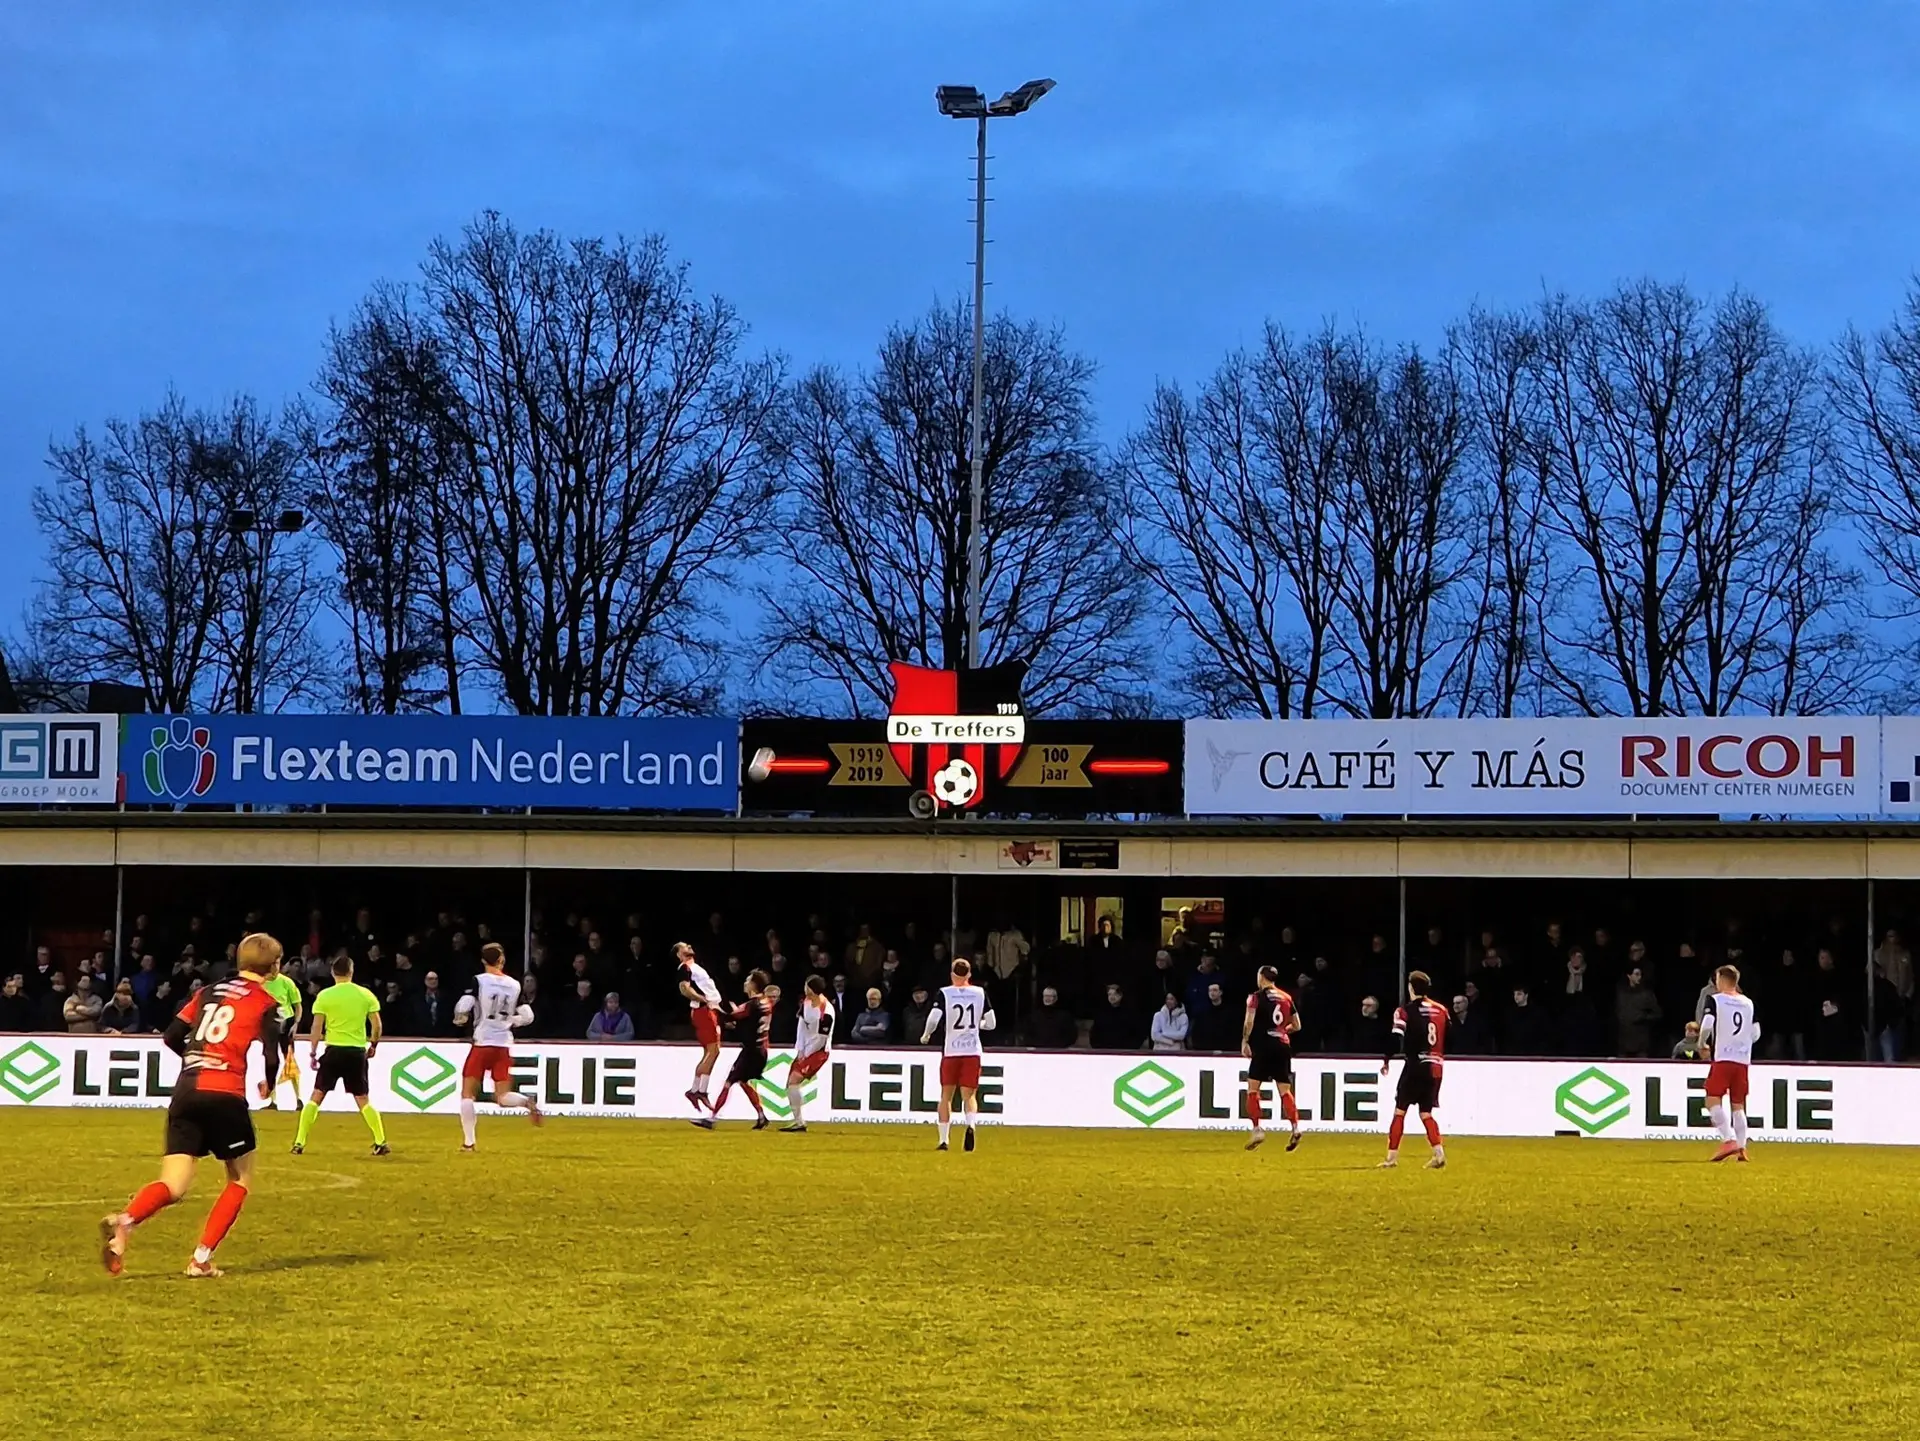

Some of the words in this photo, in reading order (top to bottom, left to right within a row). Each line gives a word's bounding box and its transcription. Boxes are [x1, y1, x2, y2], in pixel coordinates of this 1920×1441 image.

[996, 703, 1018, 714] 1919
[896, 721, 922, 737] De
[931, 721, 1016, 737] Treffers
[232, 736, 457, 782] Flexteam
[471, 738, 723, 785] Nederland
[848, 747, 884, 763] 1919
[1042, 747, 1069, 763] 100
[1259, 738, 1395, 789] CAFÉ
[1414, 751, 1454, 788] Y
[1471, 737, 1585, 789] MÁS
[1621, 735, 1855, 778] RICOH
[848, 766, 884, 782] 2019
[1041, 767, 1069, 783] jaar
[1, 787, 49, 797] GROEP
[57, 787, 99, 797] MOOK
[1620, 783, 1709, 796] DOCUMENT
[1714, 783, 1771, 796] CENTER
[1777, 783, 1855, 796] NIJMEGEN
[195, 1003, 235, 1044] 18
[952, 1003, 976, 1030] 21
[1272, 1005, 1284, 1025] 6
[1732, 1011, 1743, 1036] 9
[1427, 1023, 1438, 1046] 8
